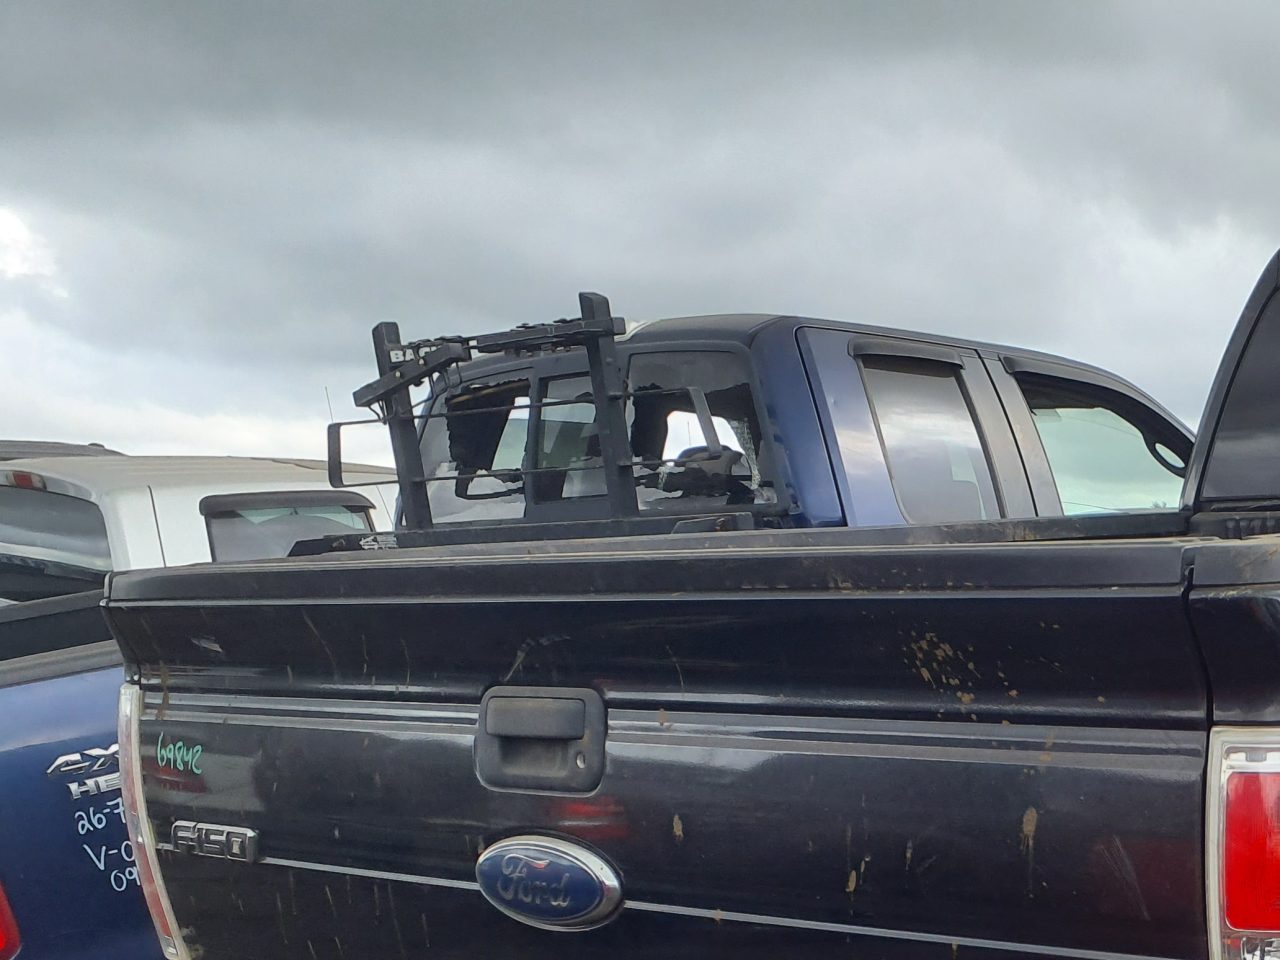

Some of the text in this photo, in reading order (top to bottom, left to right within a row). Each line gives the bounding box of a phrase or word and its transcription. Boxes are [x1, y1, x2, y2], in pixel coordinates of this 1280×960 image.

[46, 743, 120, 774] 4X
[156, 731, 203, 774] 69842
[66, 772, 121, 800] HE
[74, 797, 127, 835] 26-7
[110, 866, 141, 892] 09
[497, 852, 571, 906] Ford
